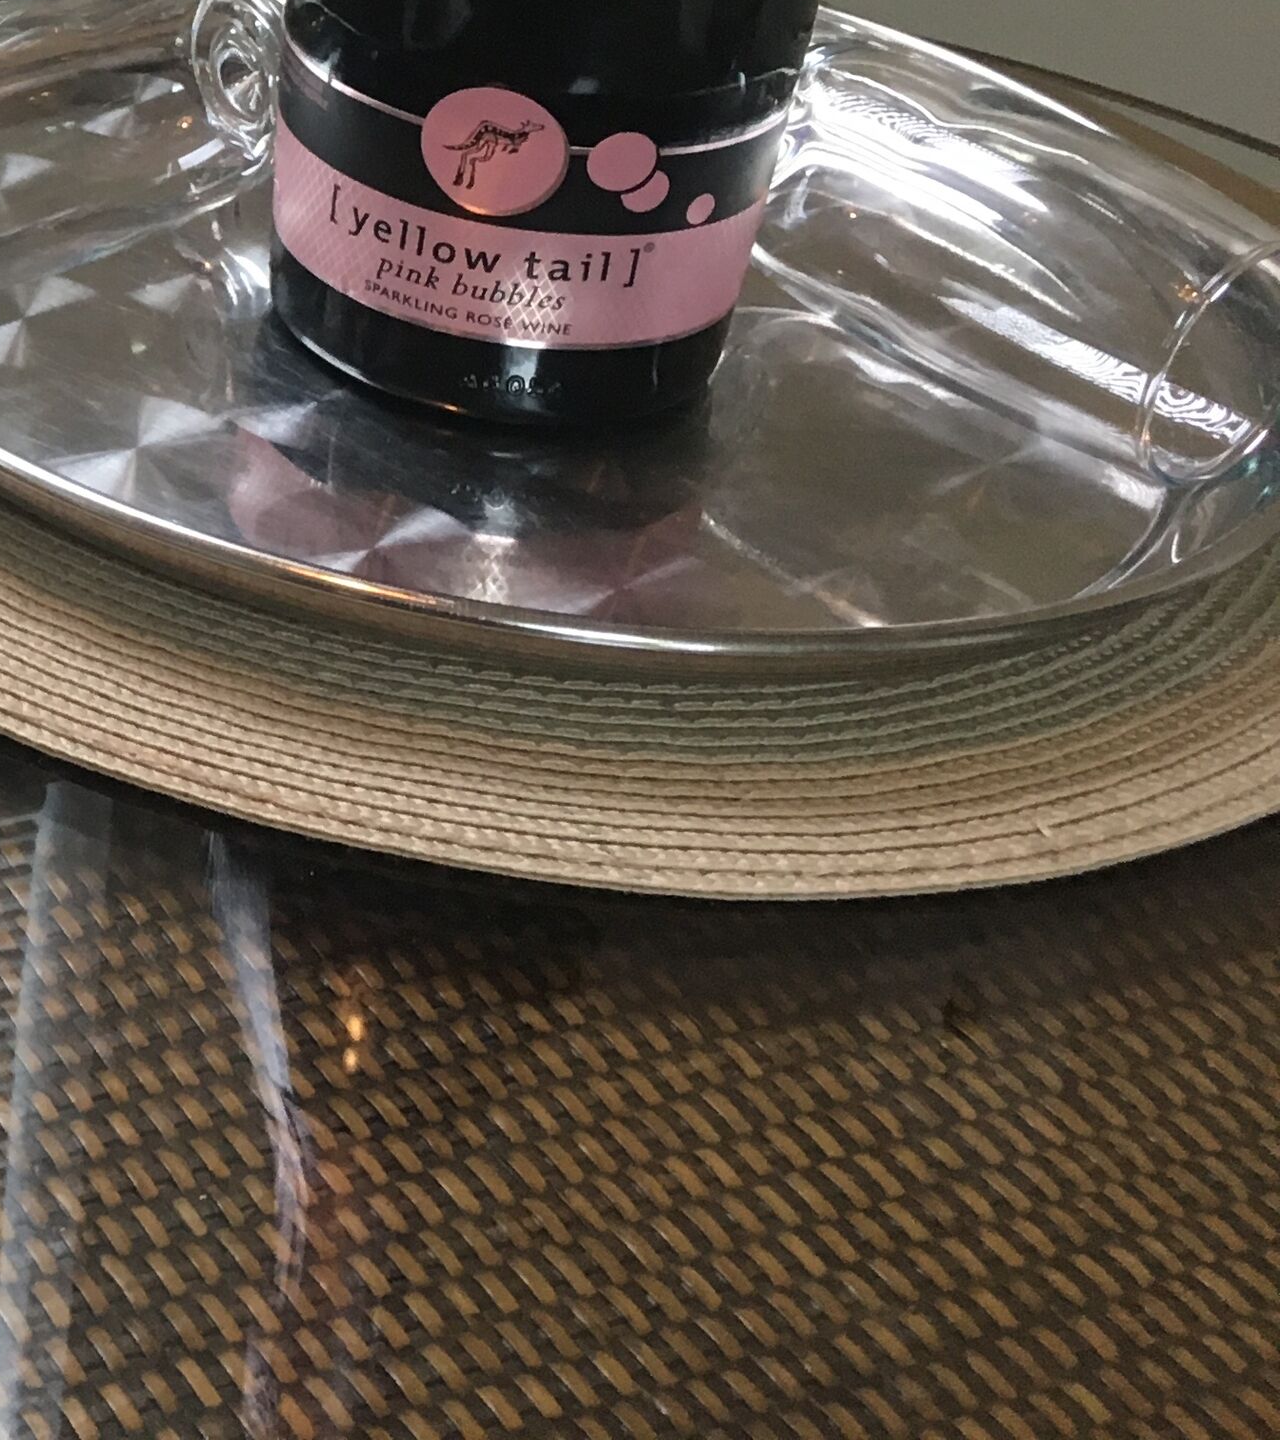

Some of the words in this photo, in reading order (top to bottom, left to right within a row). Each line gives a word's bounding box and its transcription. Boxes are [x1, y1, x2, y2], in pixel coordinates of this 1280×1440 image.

[363, 278, 459, 321] SPARKLING
[520, 320, 574, 337] WINE
[375, 257, 440, 290] pink
[451, 272, 567, 312] bubbles
